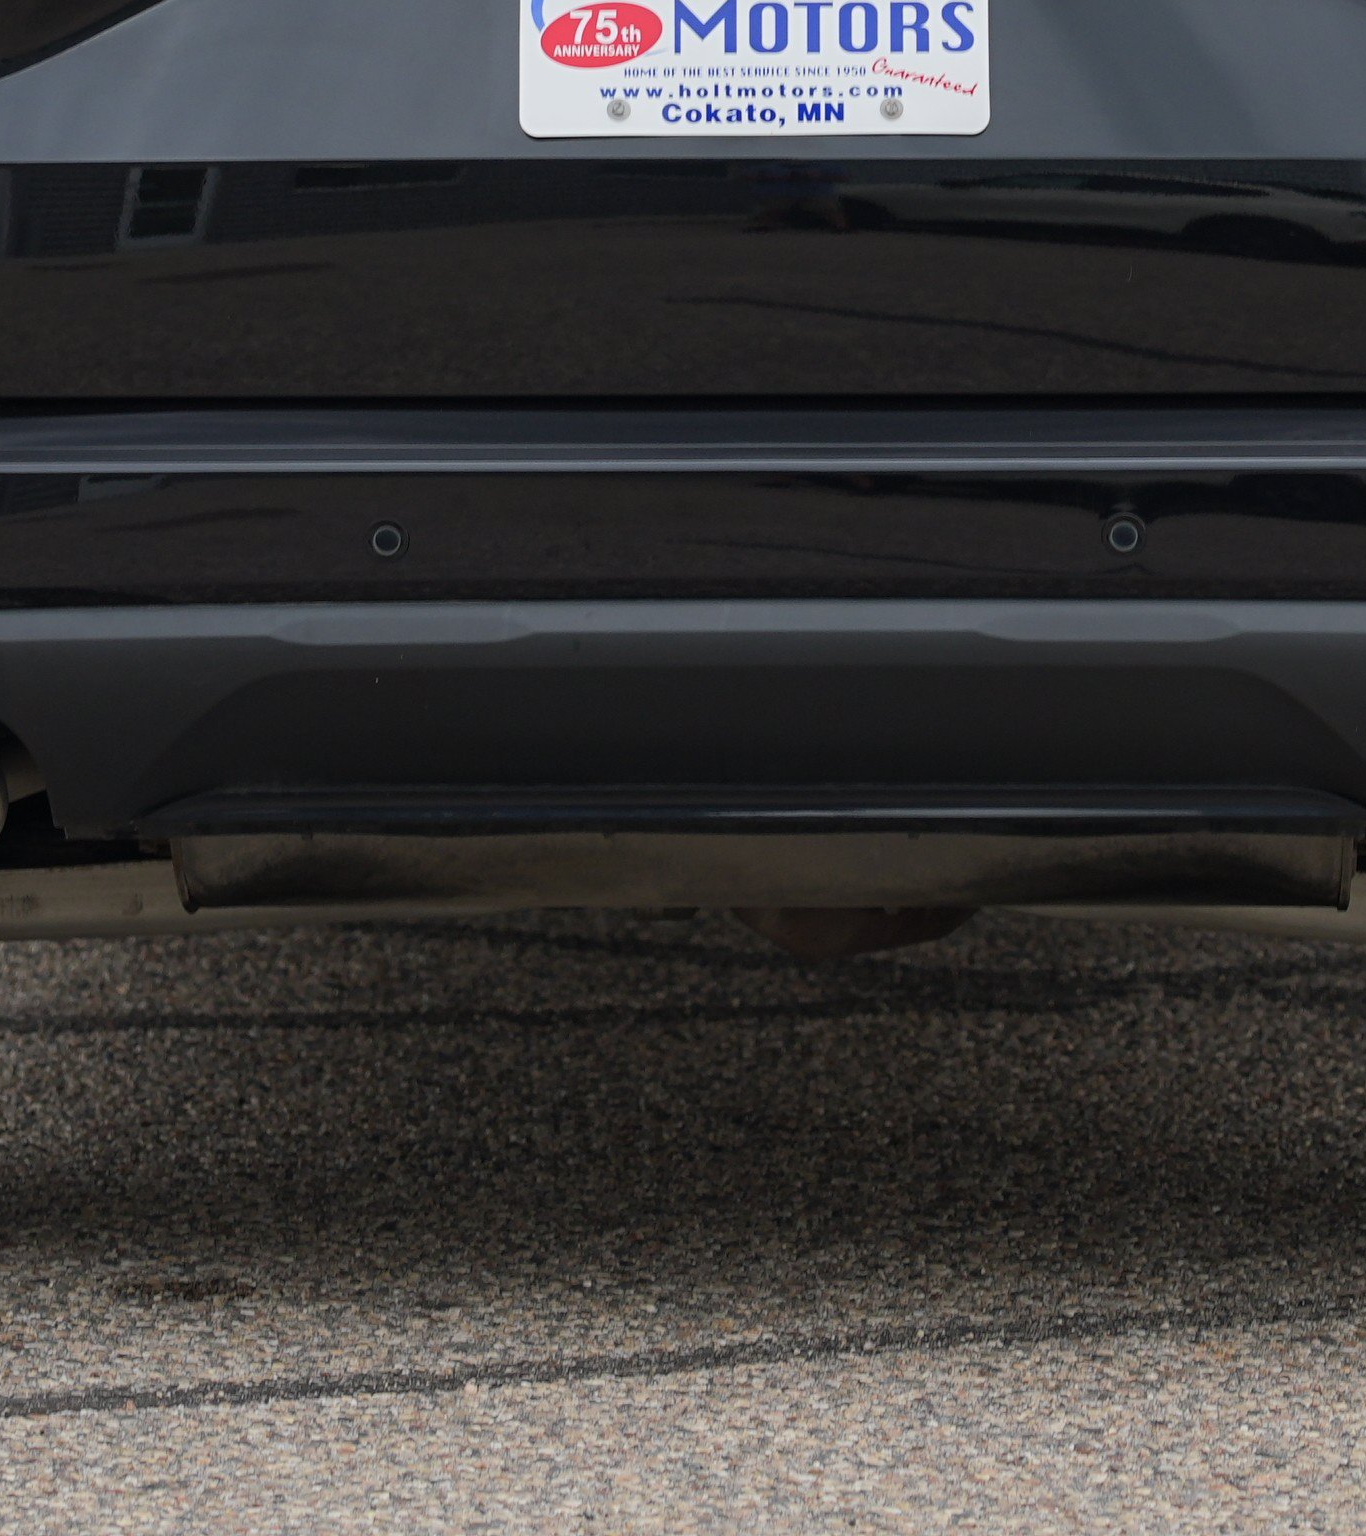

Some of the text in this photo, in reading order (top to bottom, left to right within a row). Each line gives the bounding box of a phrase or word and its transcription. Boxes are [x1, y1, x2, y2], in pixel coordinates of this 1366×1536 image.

[569, 9, 641, 44] 75th
[553, 44, 641, 57] ANNIVERSARY
[624, 66, 657, 78] HOME
[663, 66, 676, 78] OF
[683, 66, 701, 78] THE
[740, 66, 790, 78] SERVICE
[795, 66, 830, 78] SINCE
[837, 65, 867, 77] 1950
[871, 56, 978, 96] Guaranteed
[600, 83, 903, 98] www.holtmotors.com
[661, 102, 845, 127] Cokato, MN
